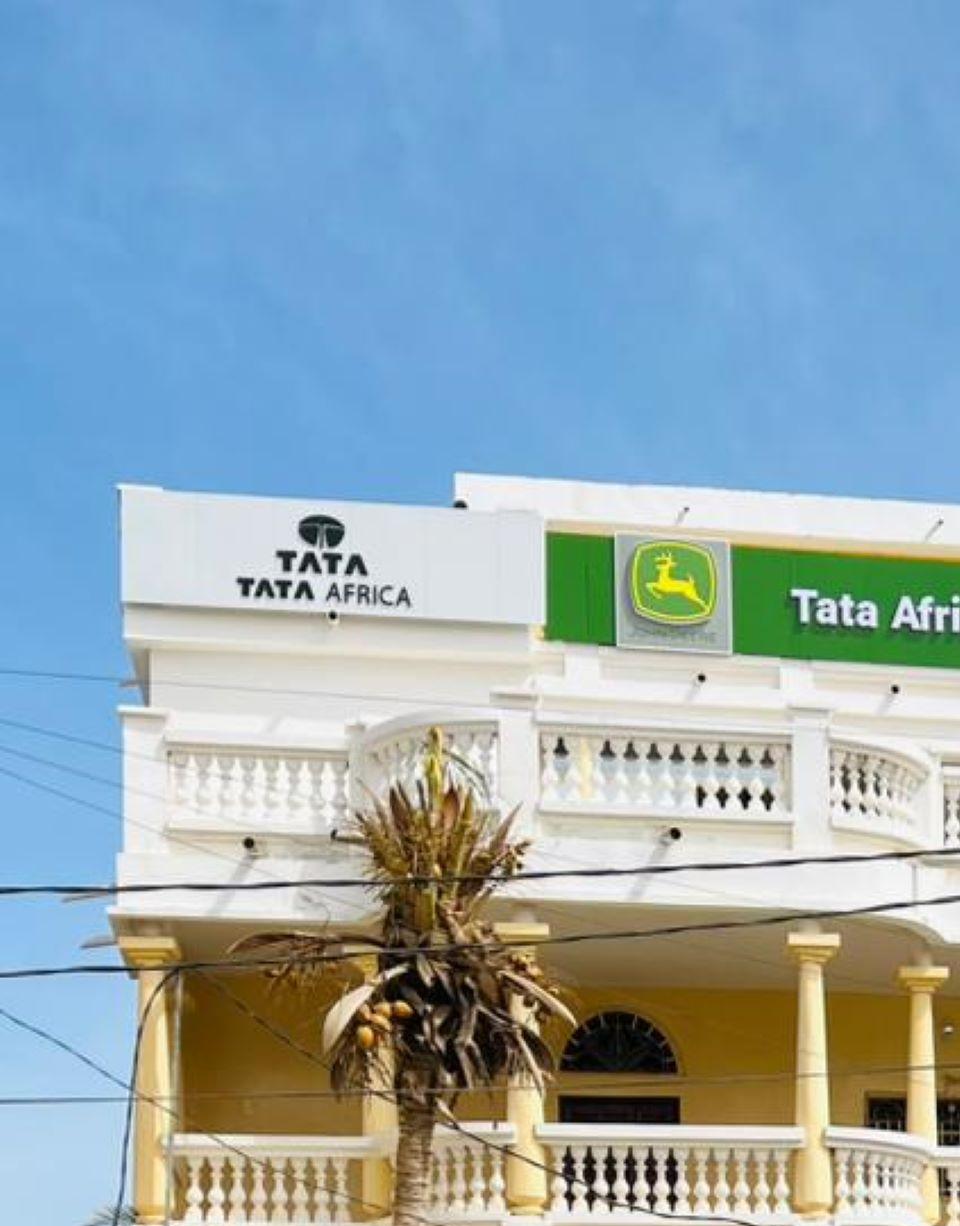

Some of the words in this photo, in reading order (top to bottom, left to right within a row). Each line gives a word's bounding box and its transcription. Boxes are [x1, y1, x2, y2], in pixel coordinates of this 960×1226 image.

[275, 550, 368, 577] TATA
[236, 577, 316, 600] TATA
[325, 582, 411, 608] AFRICA
[790, 588, 879, 629] Tata
